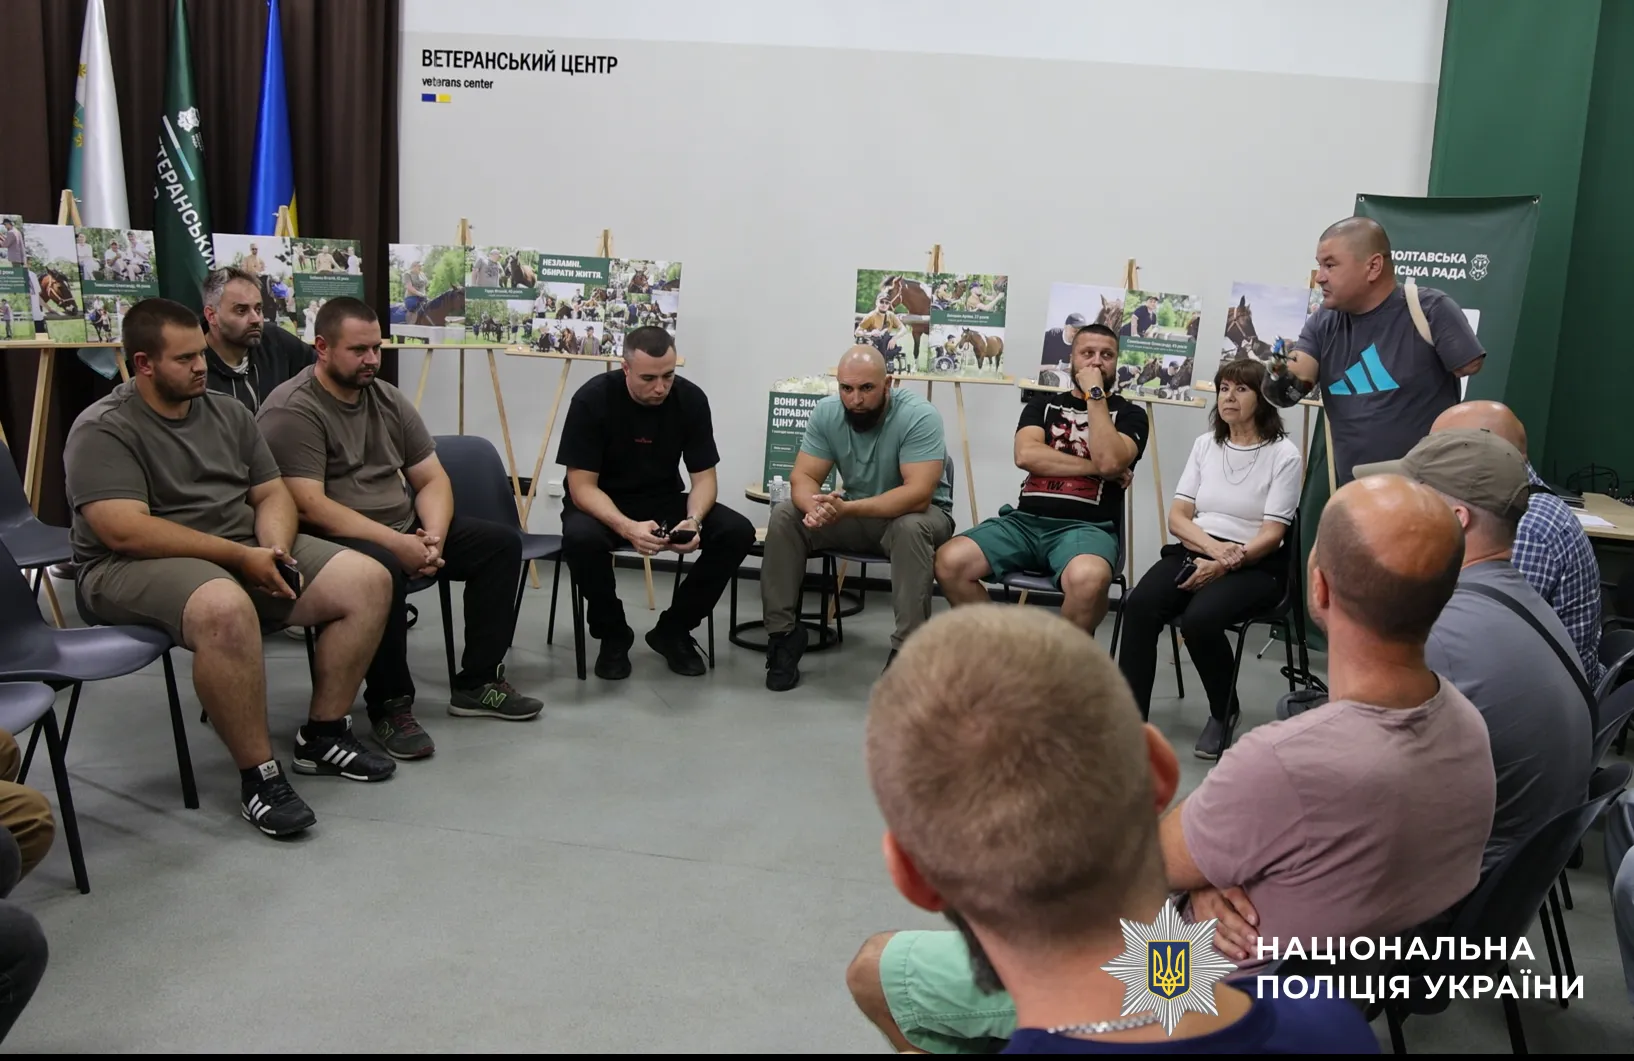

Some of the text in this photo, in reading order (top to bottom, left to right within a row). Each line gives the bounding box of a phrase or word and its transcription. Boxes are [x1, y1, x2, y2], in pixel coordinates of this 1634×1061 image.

[421, 49, 618, 76] ВЕТЕРАНСЬКИЙ ЦЕНТР
[422, 77, 494, 89] veterans center
[157, 135, 216, 271] ТЕРАНСЬКИ
[542, 258, 582, 268] НЕЗЛАМНІ.
[541, 268, 603, 280] ОБИРАТИ ЖИТТЯ.
[1431, 267, 1467, 280] РАДА
[774, 397, 819, 408] ВОНИ ЗНА
[772, 418, 794, 429] ЦІНУ
